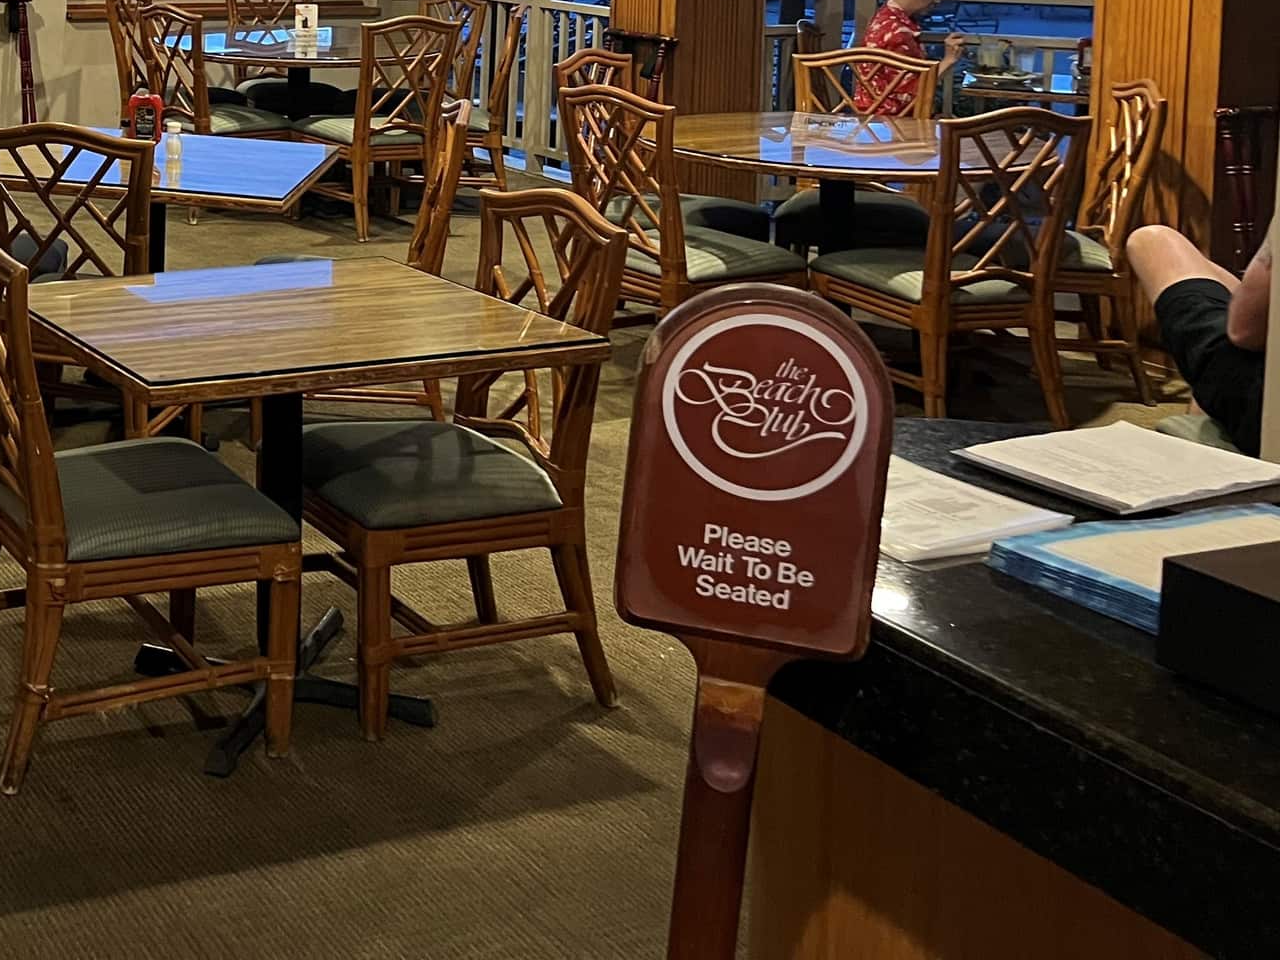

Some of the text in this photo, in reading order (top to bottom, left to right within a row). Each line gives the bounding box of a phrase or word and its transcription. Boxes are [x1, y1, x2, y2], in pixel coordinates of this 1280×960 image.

[775, 358, 809, 381] the
[675, 361, 857, 425] Beach
[711, 402, 847, 459] Club
[703, 523, 792, 557] Please
[677, 544, 815, 587] Wait To Be
[695, 574, 790, 610] Seated
